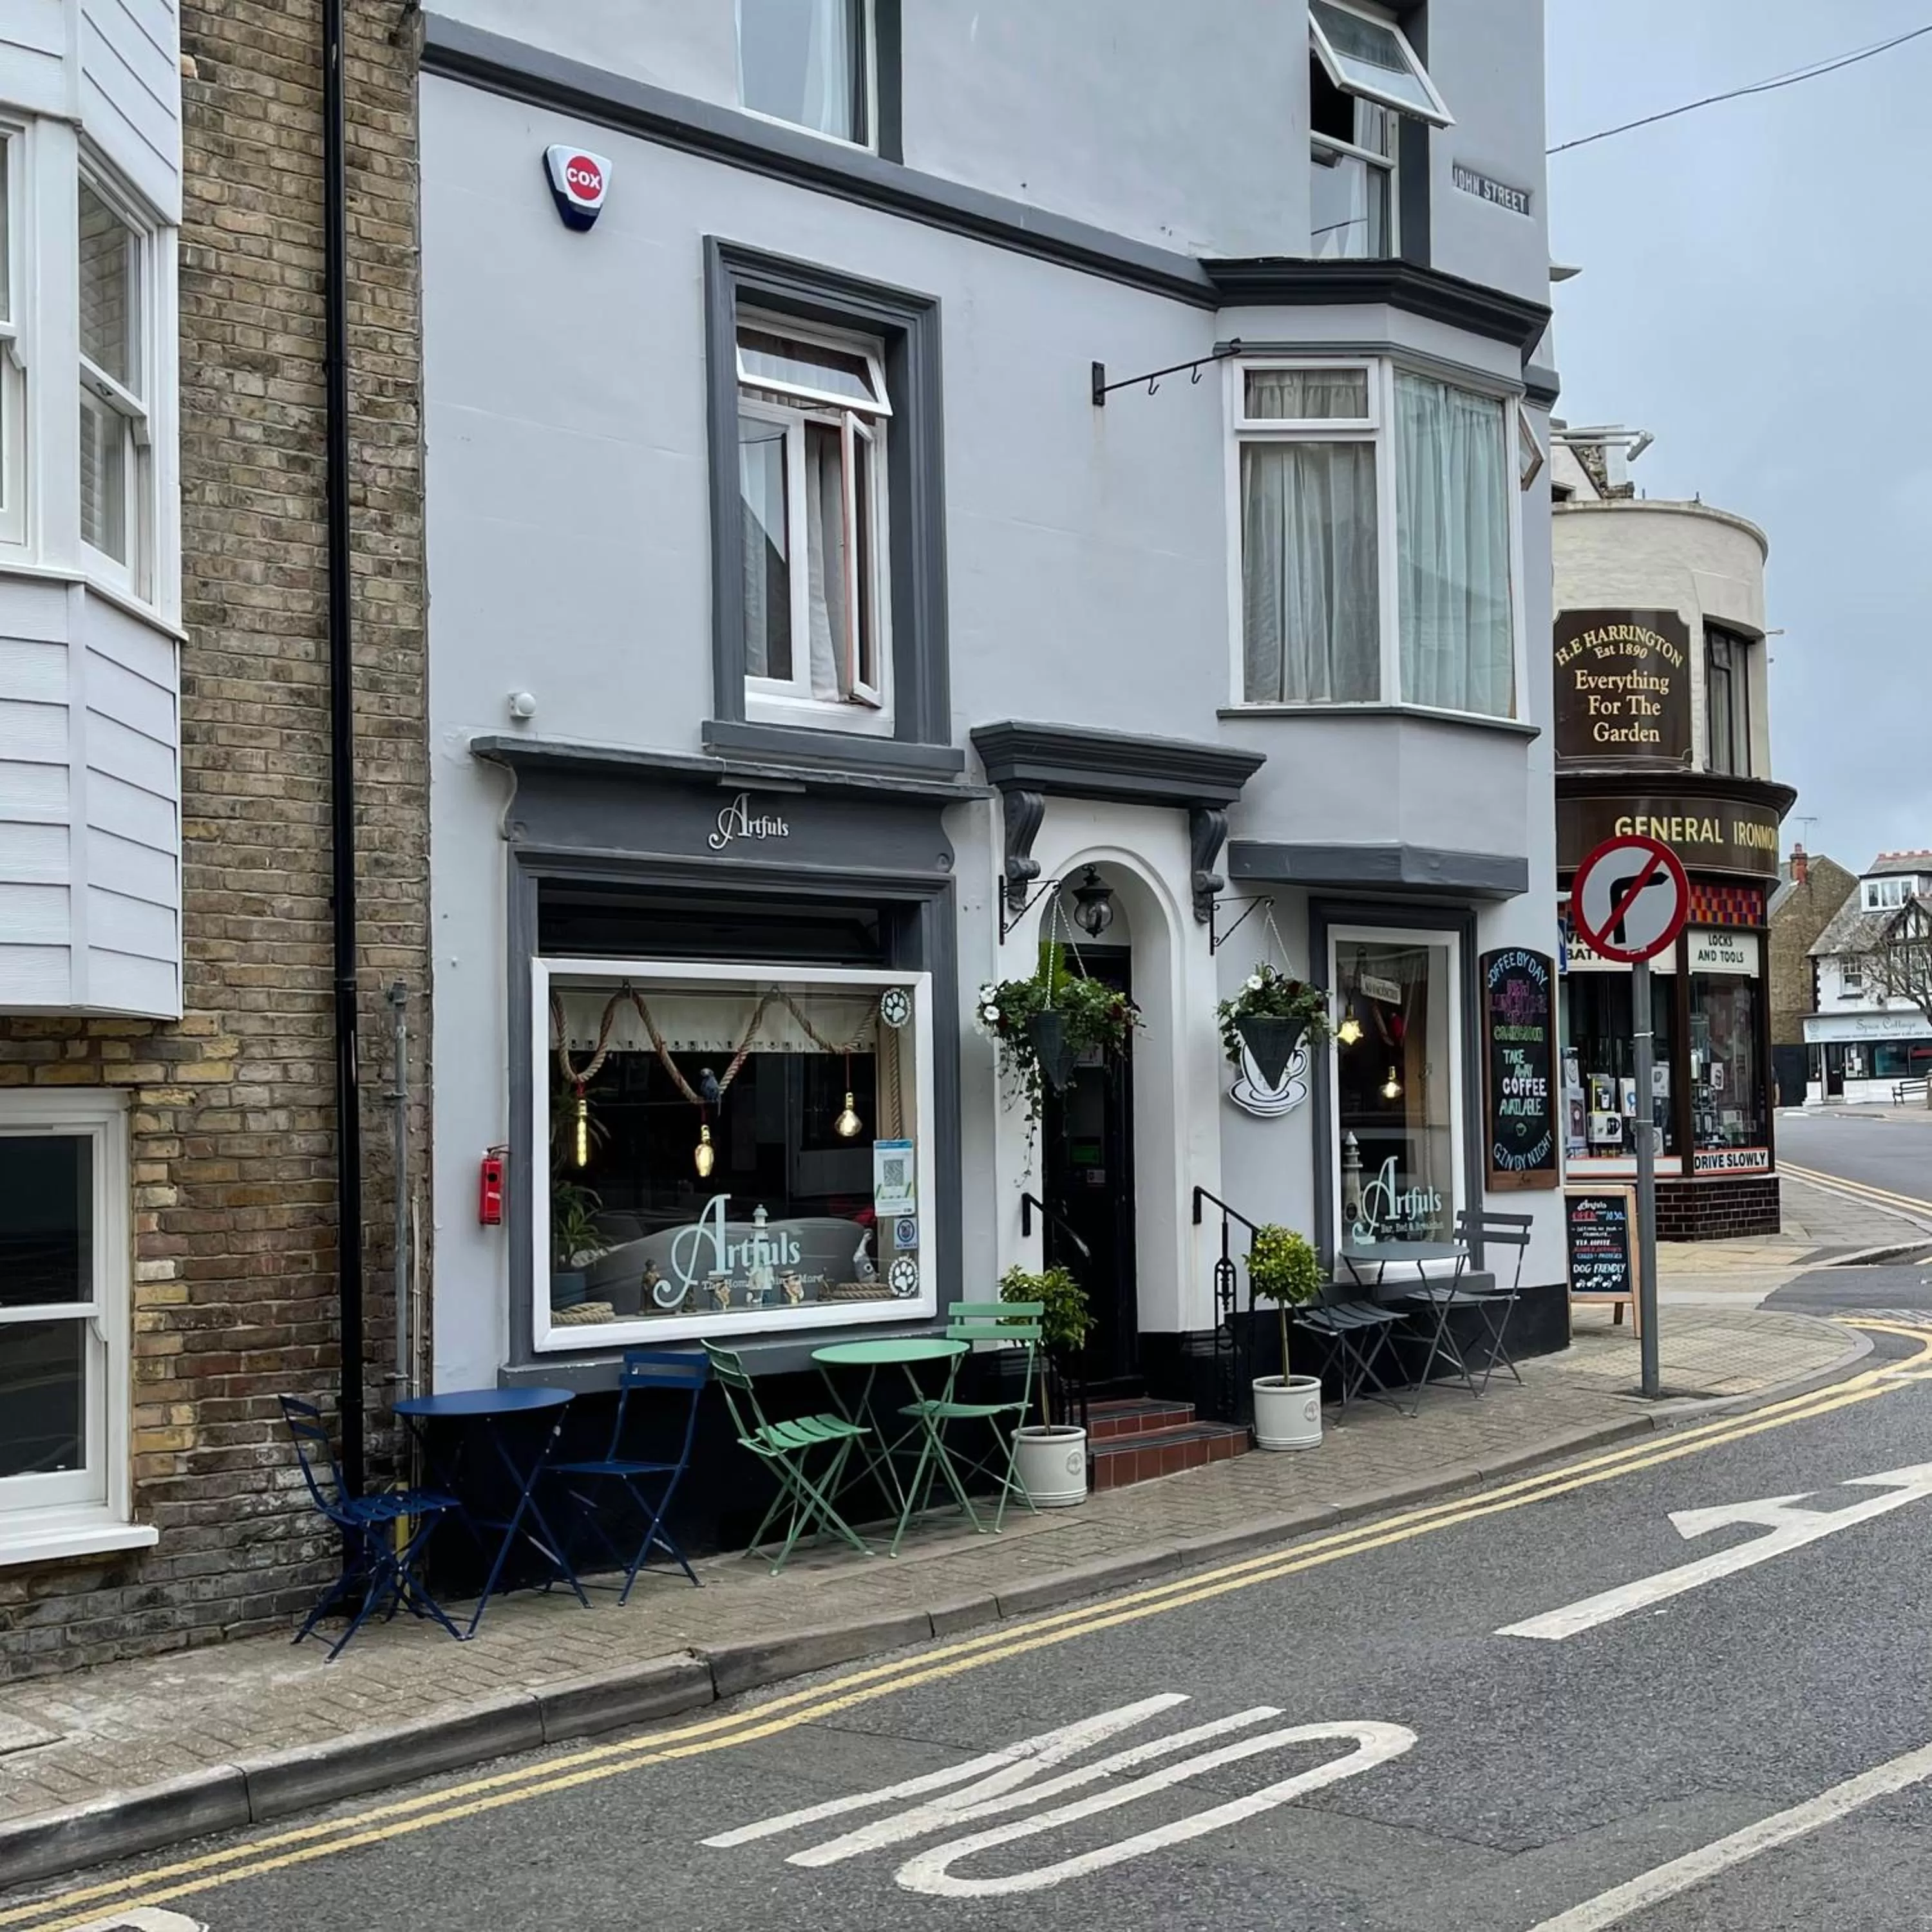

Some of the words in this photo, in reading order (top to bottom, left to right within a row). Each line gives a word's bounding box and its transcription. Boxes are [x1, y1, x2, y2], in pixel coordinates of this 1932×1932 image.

[567, 167, 600, 189] COX
[1452, 167, 1480, 196] JOHN
[1484, 180, 1526, 212] STREET
[1583, 624, 1683, 668] HARRINGTON
[1593, 645, 1616, 659] Est
[1620, 643, 1648, 659] 1890
[1575, 669, 1670, 695] Everything
[1588, 695, 1621, 715] For
[1626, 695, 1662, 715] The
[1593, 721, 1660, 742] Garden
[708, 793, 789, 849] Artfuls
[1615, 816, 1724, 844] GENERAL
[1734, 821, 1777, 851] IRONMO
[1709, 933, 1733, 947] LOCKS
[1698, 949, 1717, 961] AND
[1720, 951, 1744, 963] TOOLS
[1488, 952, 1516, 988] COFFEE
[1517, 951, 1530, 967] BY
[1528, 958, 1548, 986] DAY
[1502, 1049, 1525, 1065] TAKE
[1502, 1077, 1547, 1097] COFFEE
[1494, 1143, 1514, 1170] GIN
[1527, 1130, 1552, 1167] NIGHT
[1694, 1154, 1725, 1169] DRIVE
[1727, 1151, 1766, 1167] SLOWLY
[1352, 1156, 1442, 1244] Artfuls
[653, 1193, 800, 1307] Artfuls
[1573, 1264, 1592, 1273] DOG
[1593, 1263, 1626, 1274] FRIENDLY
